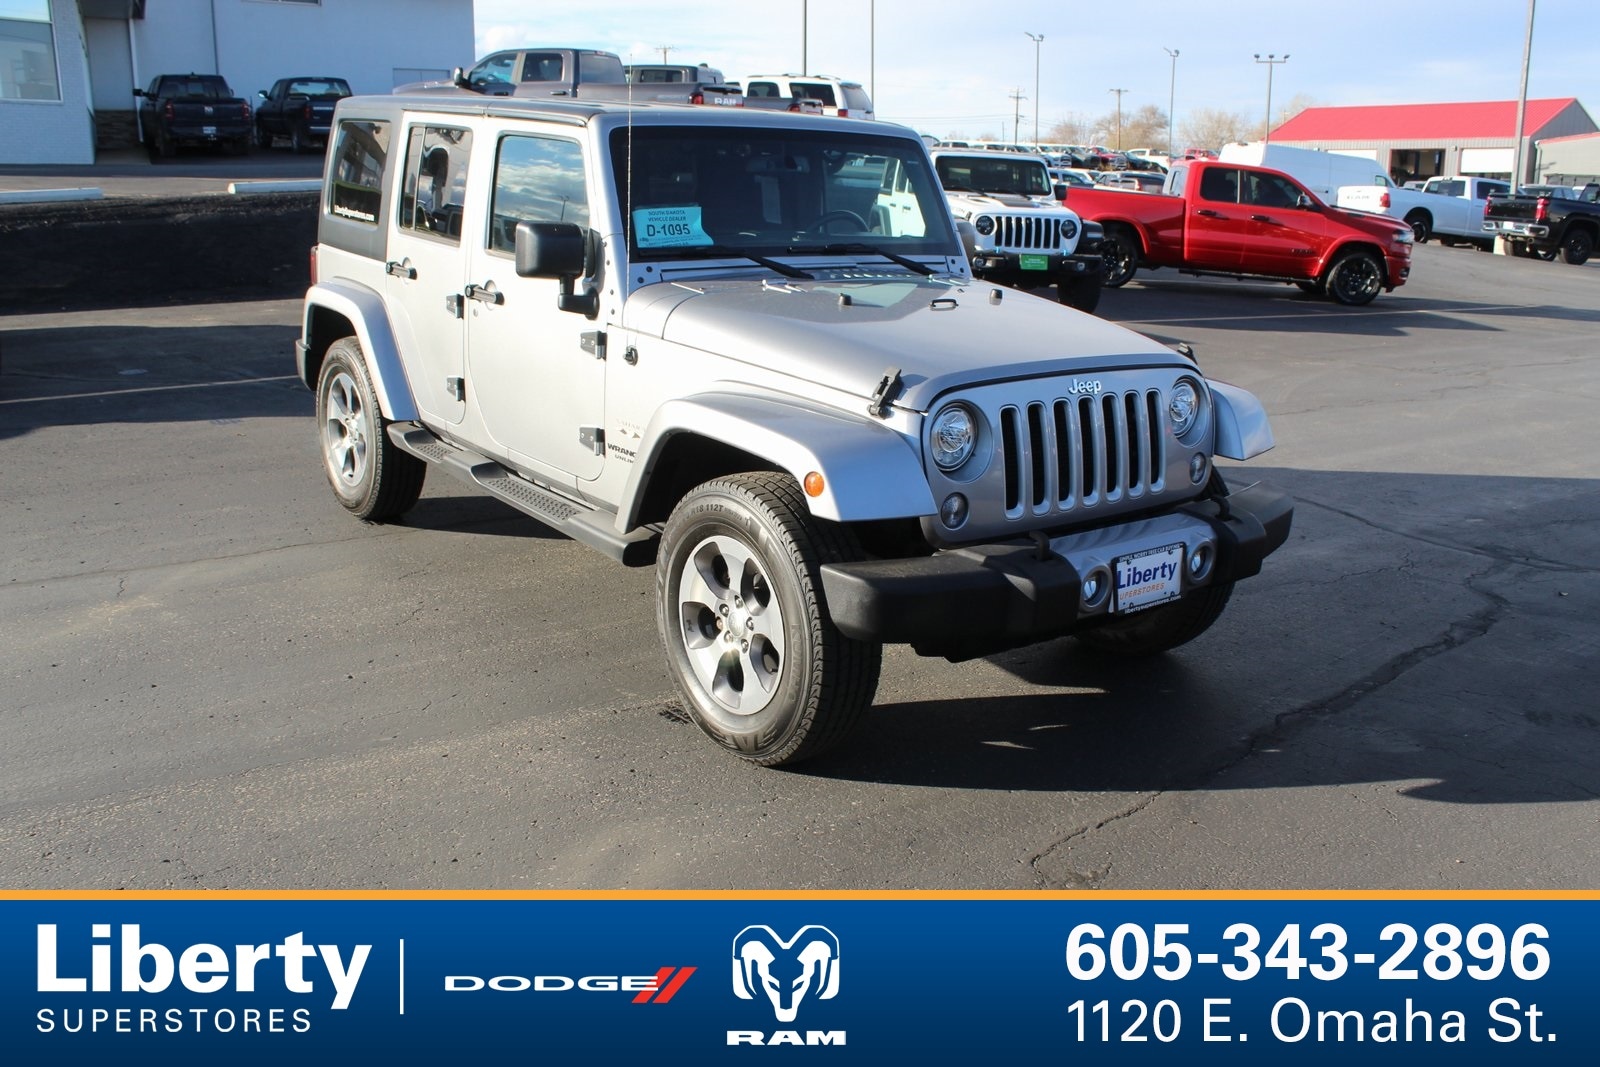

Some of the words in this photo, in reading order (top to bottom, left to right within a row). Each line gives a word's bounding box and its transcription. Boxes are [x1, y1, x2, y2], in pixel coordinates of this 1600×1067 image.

[647, 224, 691, 237] D-1095
[1068, 378, 1102, 395] Jeep
[705, 503, 724, 514] 112T
[1116, 562, 1177, 590] Liberty
[1119, 583, 1165, 600] UPERSTORES
